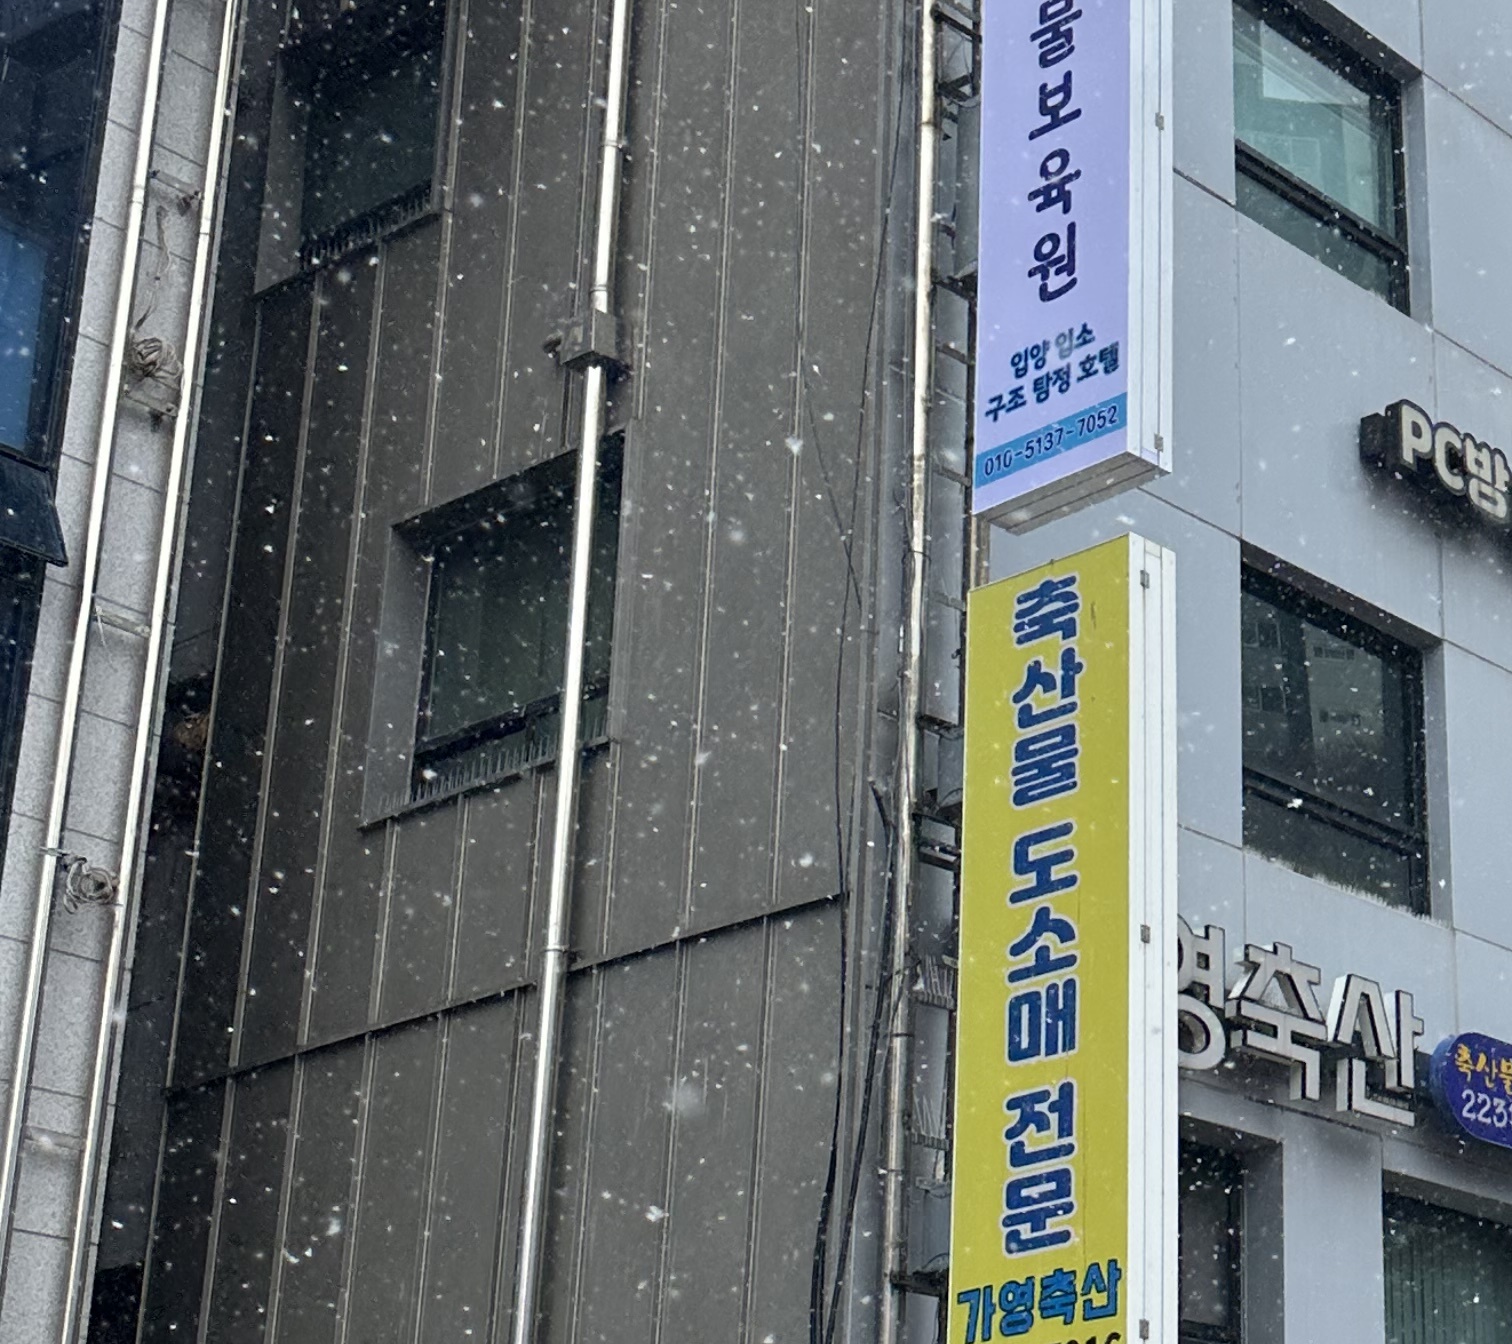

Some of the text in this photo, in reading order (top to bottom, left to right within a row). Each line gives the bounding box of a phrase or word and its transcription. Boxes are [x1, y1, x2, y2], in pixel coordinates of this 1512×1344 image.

[985, 341, 1120, 422] 구조 탐정 호텔
[1011, 322, 1095, 379] 입양 입소
[984, 405, 1118, 476] 010-5137-7052
[1399, 402, 1512, 523] PC방
[1010, 570, 1086, 813] 축산물
[1005, 821, 1077, 1066] 도소매
[1000, 1080, 1076, 1260] 전문
[957, 1260, 1122, 1344] 가영축산
